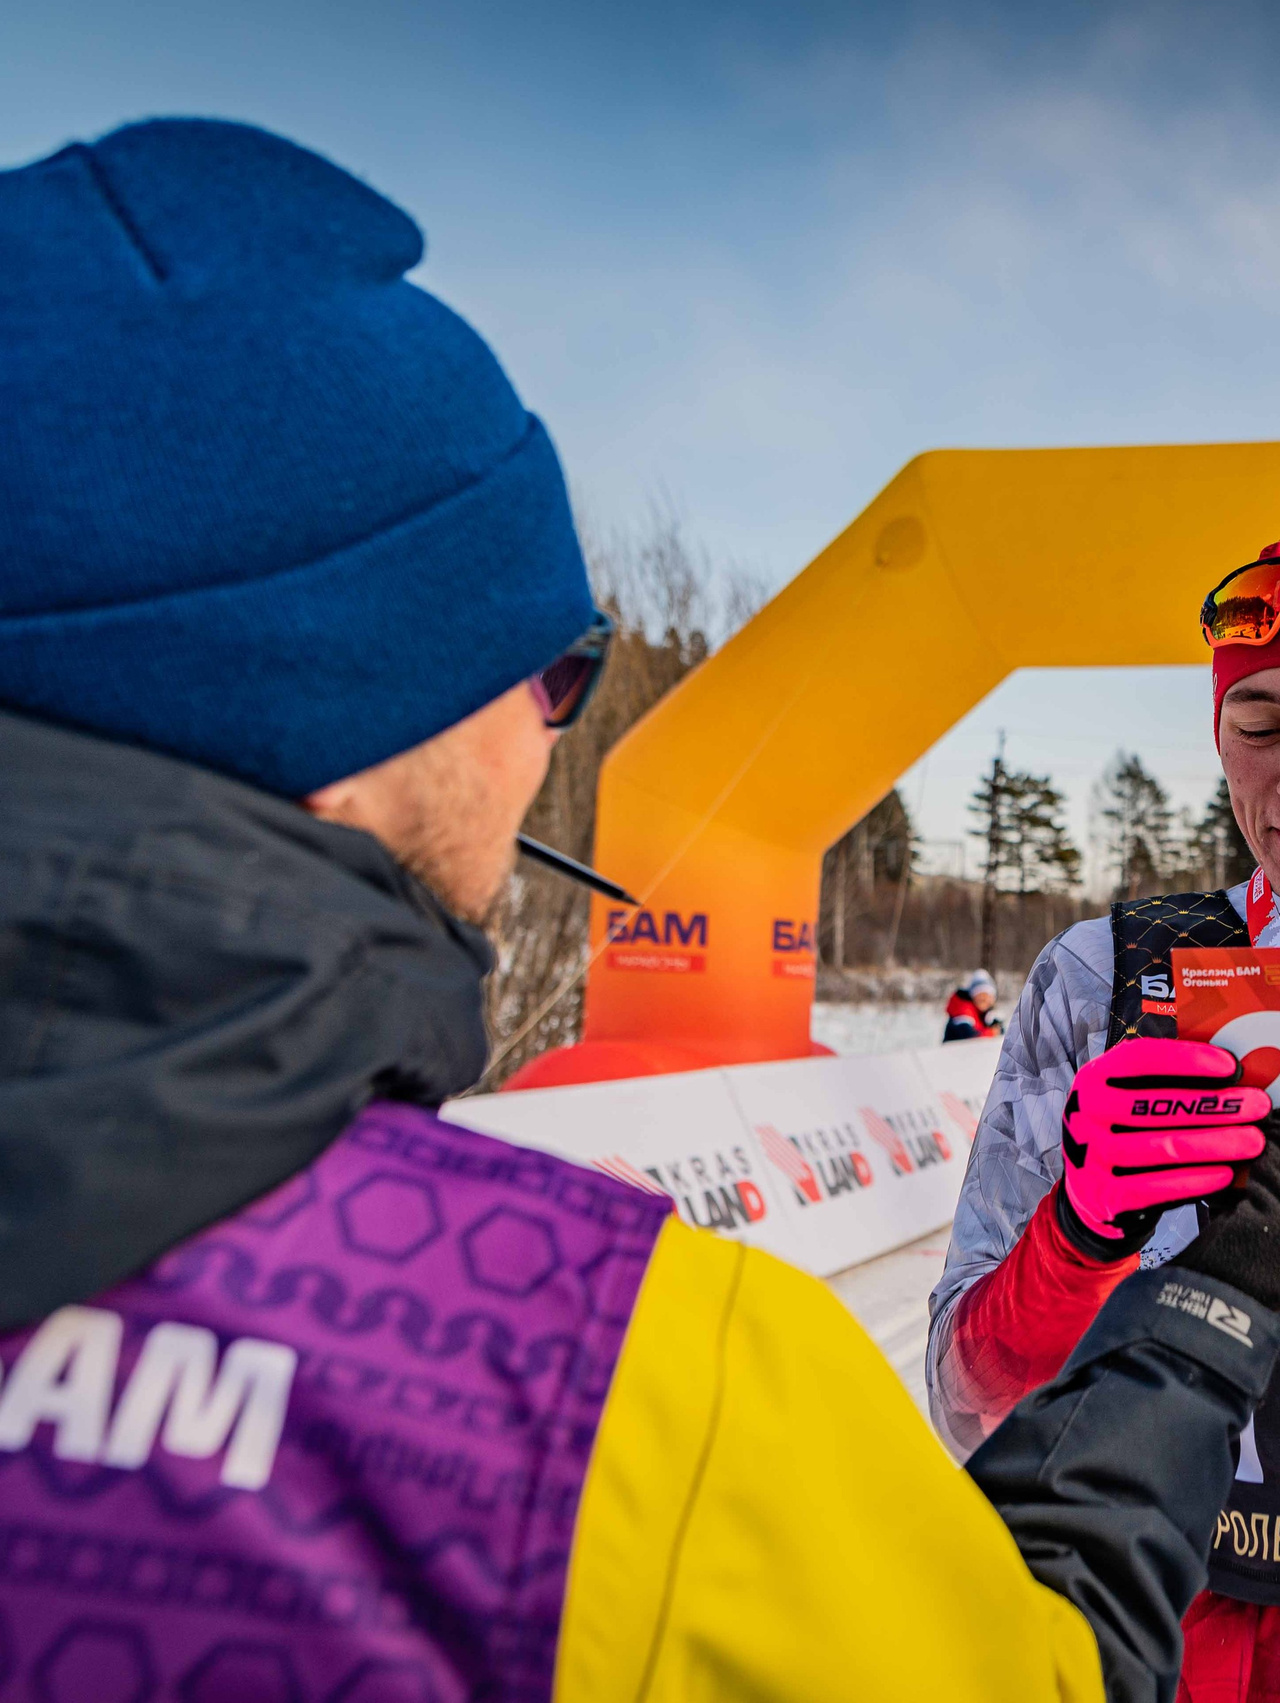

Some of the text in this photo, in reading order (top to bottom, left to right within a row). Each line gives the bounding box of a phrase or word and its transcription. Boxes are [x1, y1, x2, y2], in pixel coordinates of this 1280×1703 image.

[607, 910, 708, 947] БАМ
[772, 919, 815, 951] БА
[1182, 965, 1261, 979] Краслэнд БАМ
[1183, 977, 1229, 988] Огоньки
[663, 1147, 752, 1190] KRAS
[817, 1151, 874, 1197] LAND
[684, 1180, 767, 1230] LAND
[0, 1304, 299, 1491] АМ
